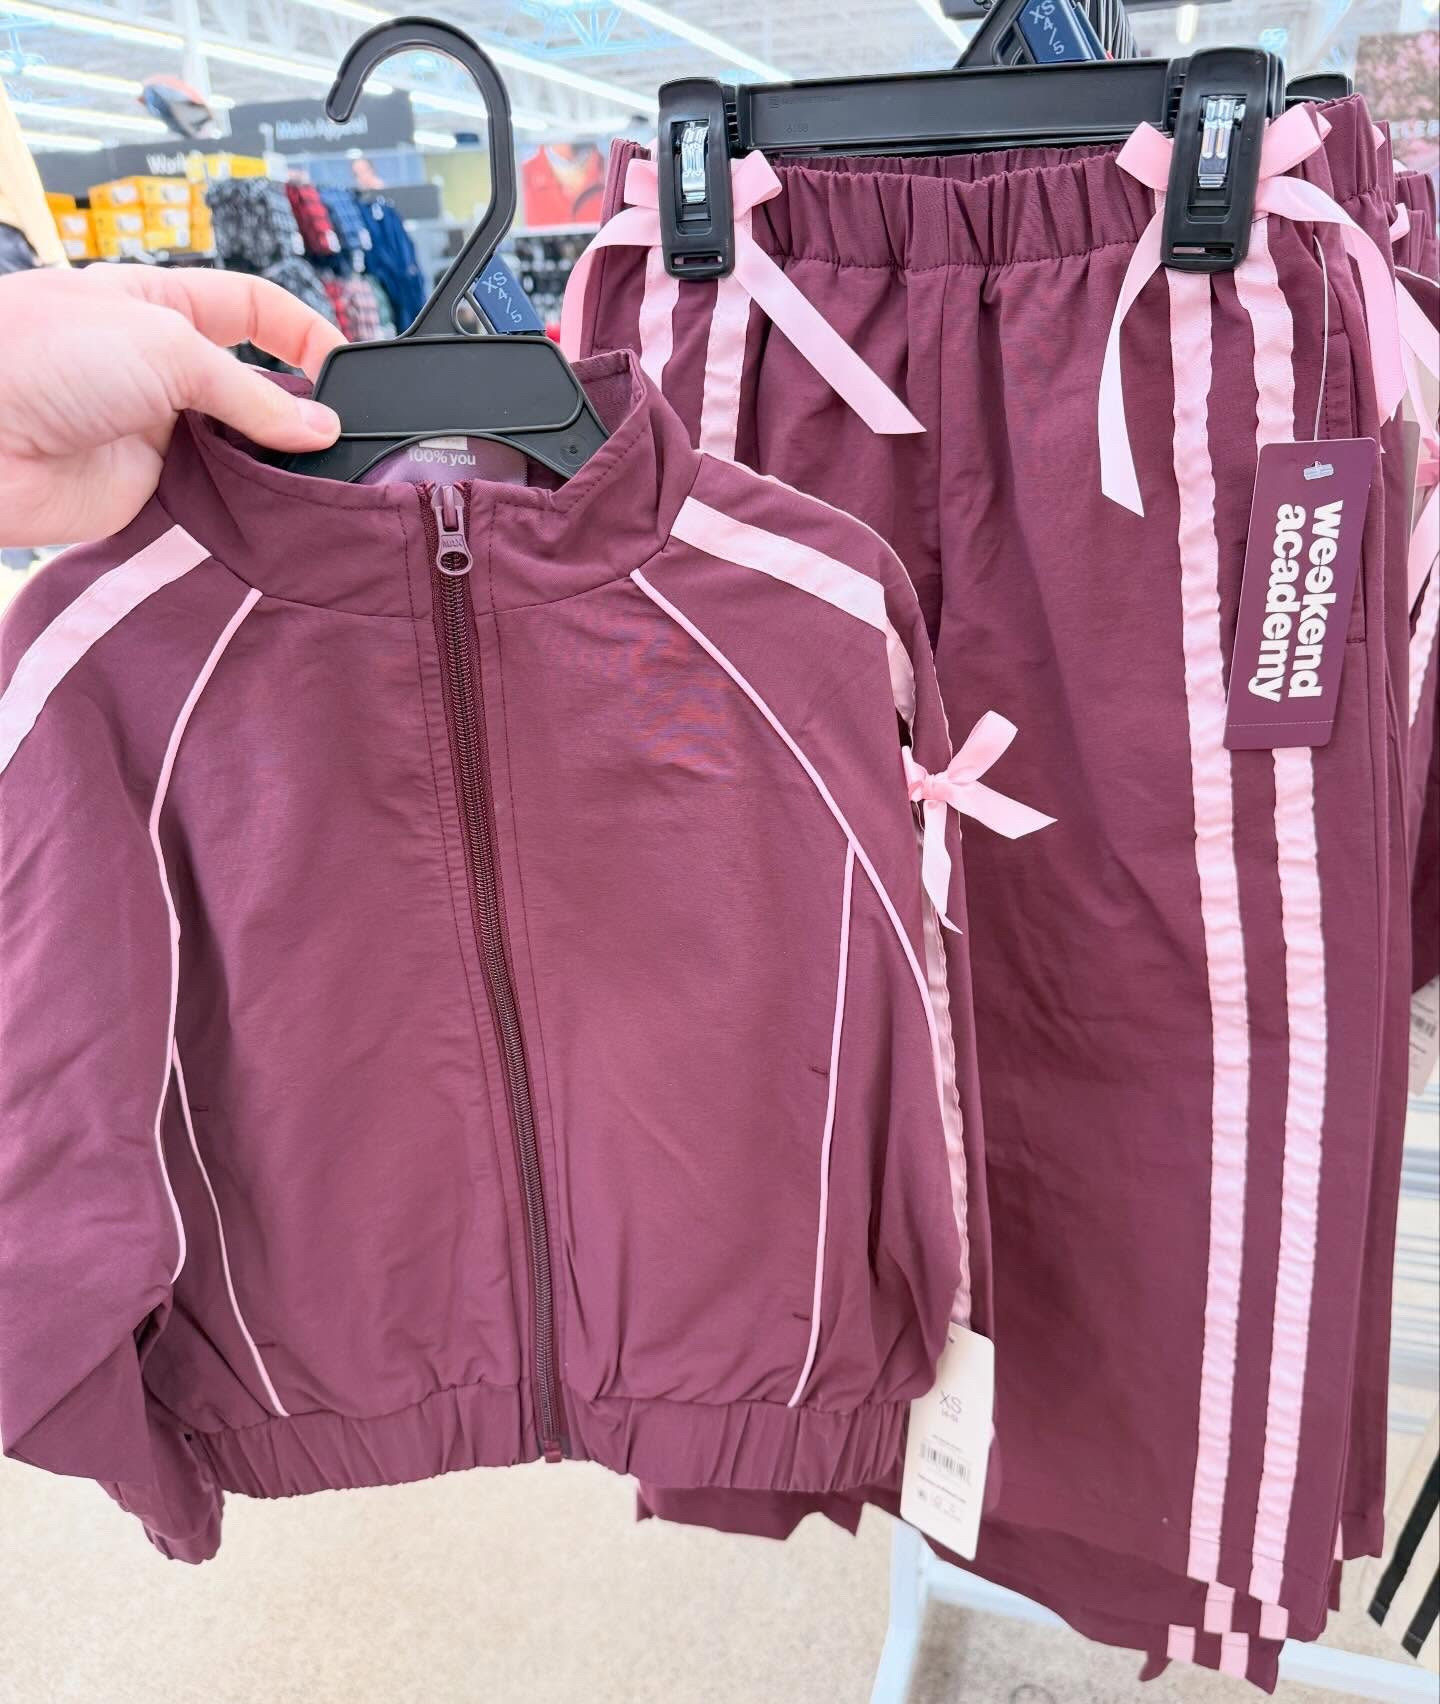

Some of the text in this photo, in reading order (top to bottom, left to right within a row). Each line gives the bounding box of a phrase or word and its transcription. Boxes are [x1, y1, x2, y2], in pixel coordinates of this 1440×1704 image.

[1029, 1, 1055, 24] XS
[1043, 16, 1065, 55] 4/5
[482, 272, 508, 294] XS
[498, 287, 522, 323] 4/5
[408, 449, 477, 466] 100% you
[1248, 503, 1306, 702] academy
[1287, 500, 1343, 698] weekend
[939, 1390, 962, 1414] XS
